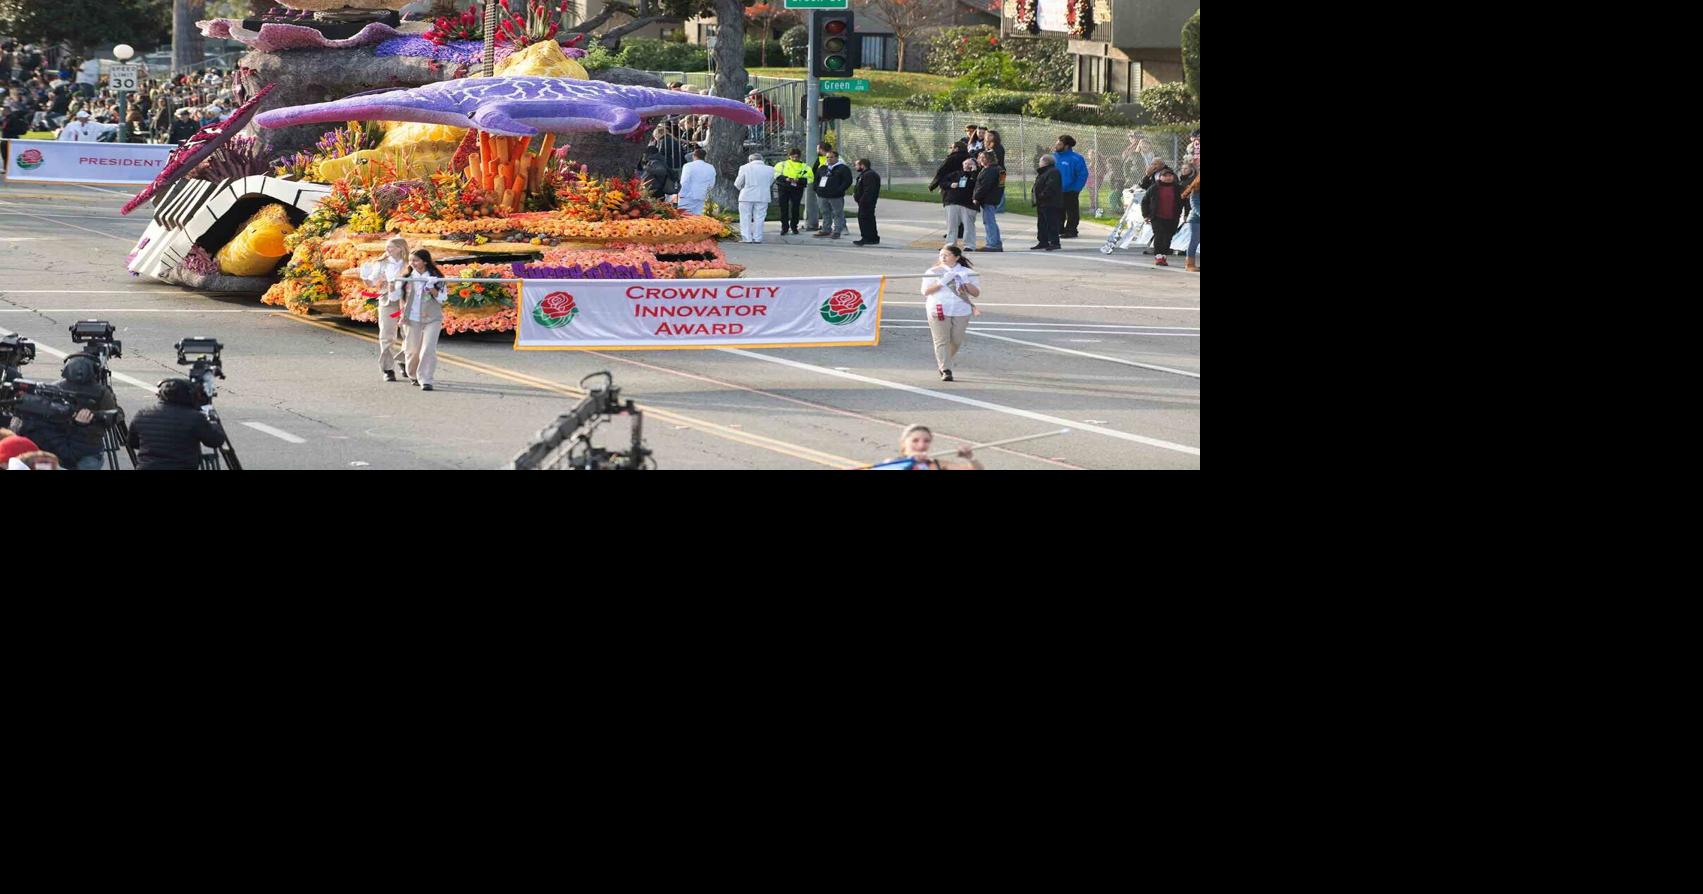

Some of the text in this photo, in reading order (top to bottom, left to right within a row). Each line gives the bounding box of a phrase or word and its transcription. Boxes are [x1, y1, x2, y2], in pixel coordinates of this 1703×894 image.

[112, 78, 134, 88] 30
[824, 80, 850, 90] Green
[79, 157, 162, 167] PRESIDENT
[625, 285, 780, 299] CROWN CITY
[634, 304, 767, 318] INNOVATOR
[654, 322, 743, 336] AWARD
